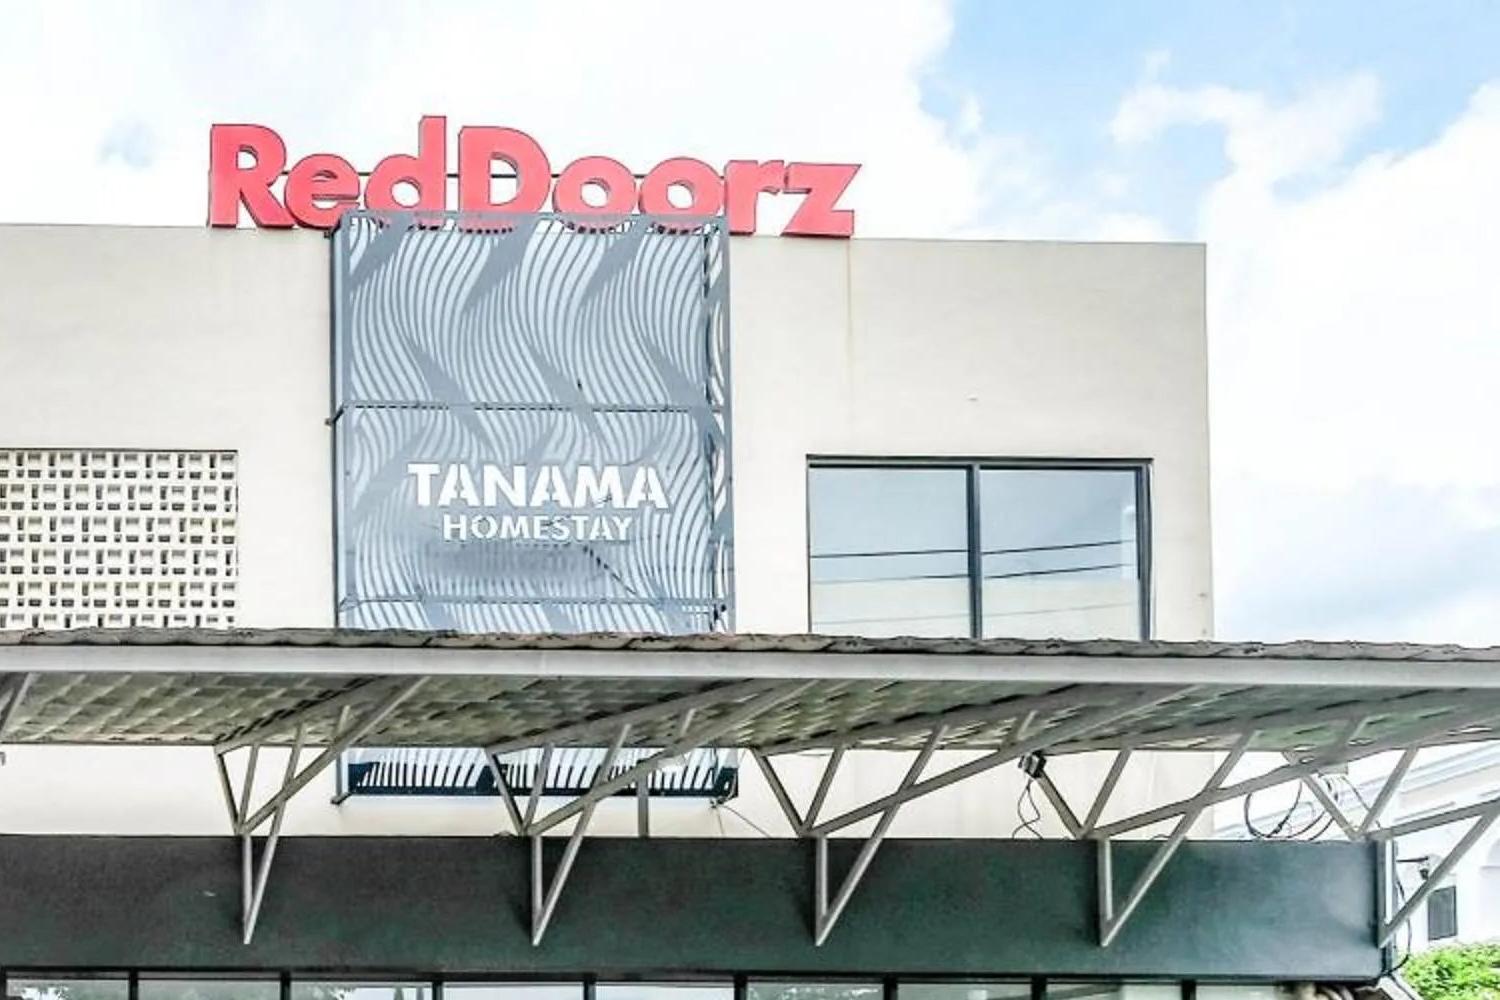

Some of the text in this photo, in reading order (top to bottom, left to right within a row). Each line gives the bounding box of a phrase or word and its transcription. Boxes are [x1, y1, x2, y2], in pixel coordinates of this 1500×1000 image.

[208, 114, 862, 237] RedDoorz
[407, 463, 669, 509] TANAMA
[442, 514, 632, 541] HOMESTAY
